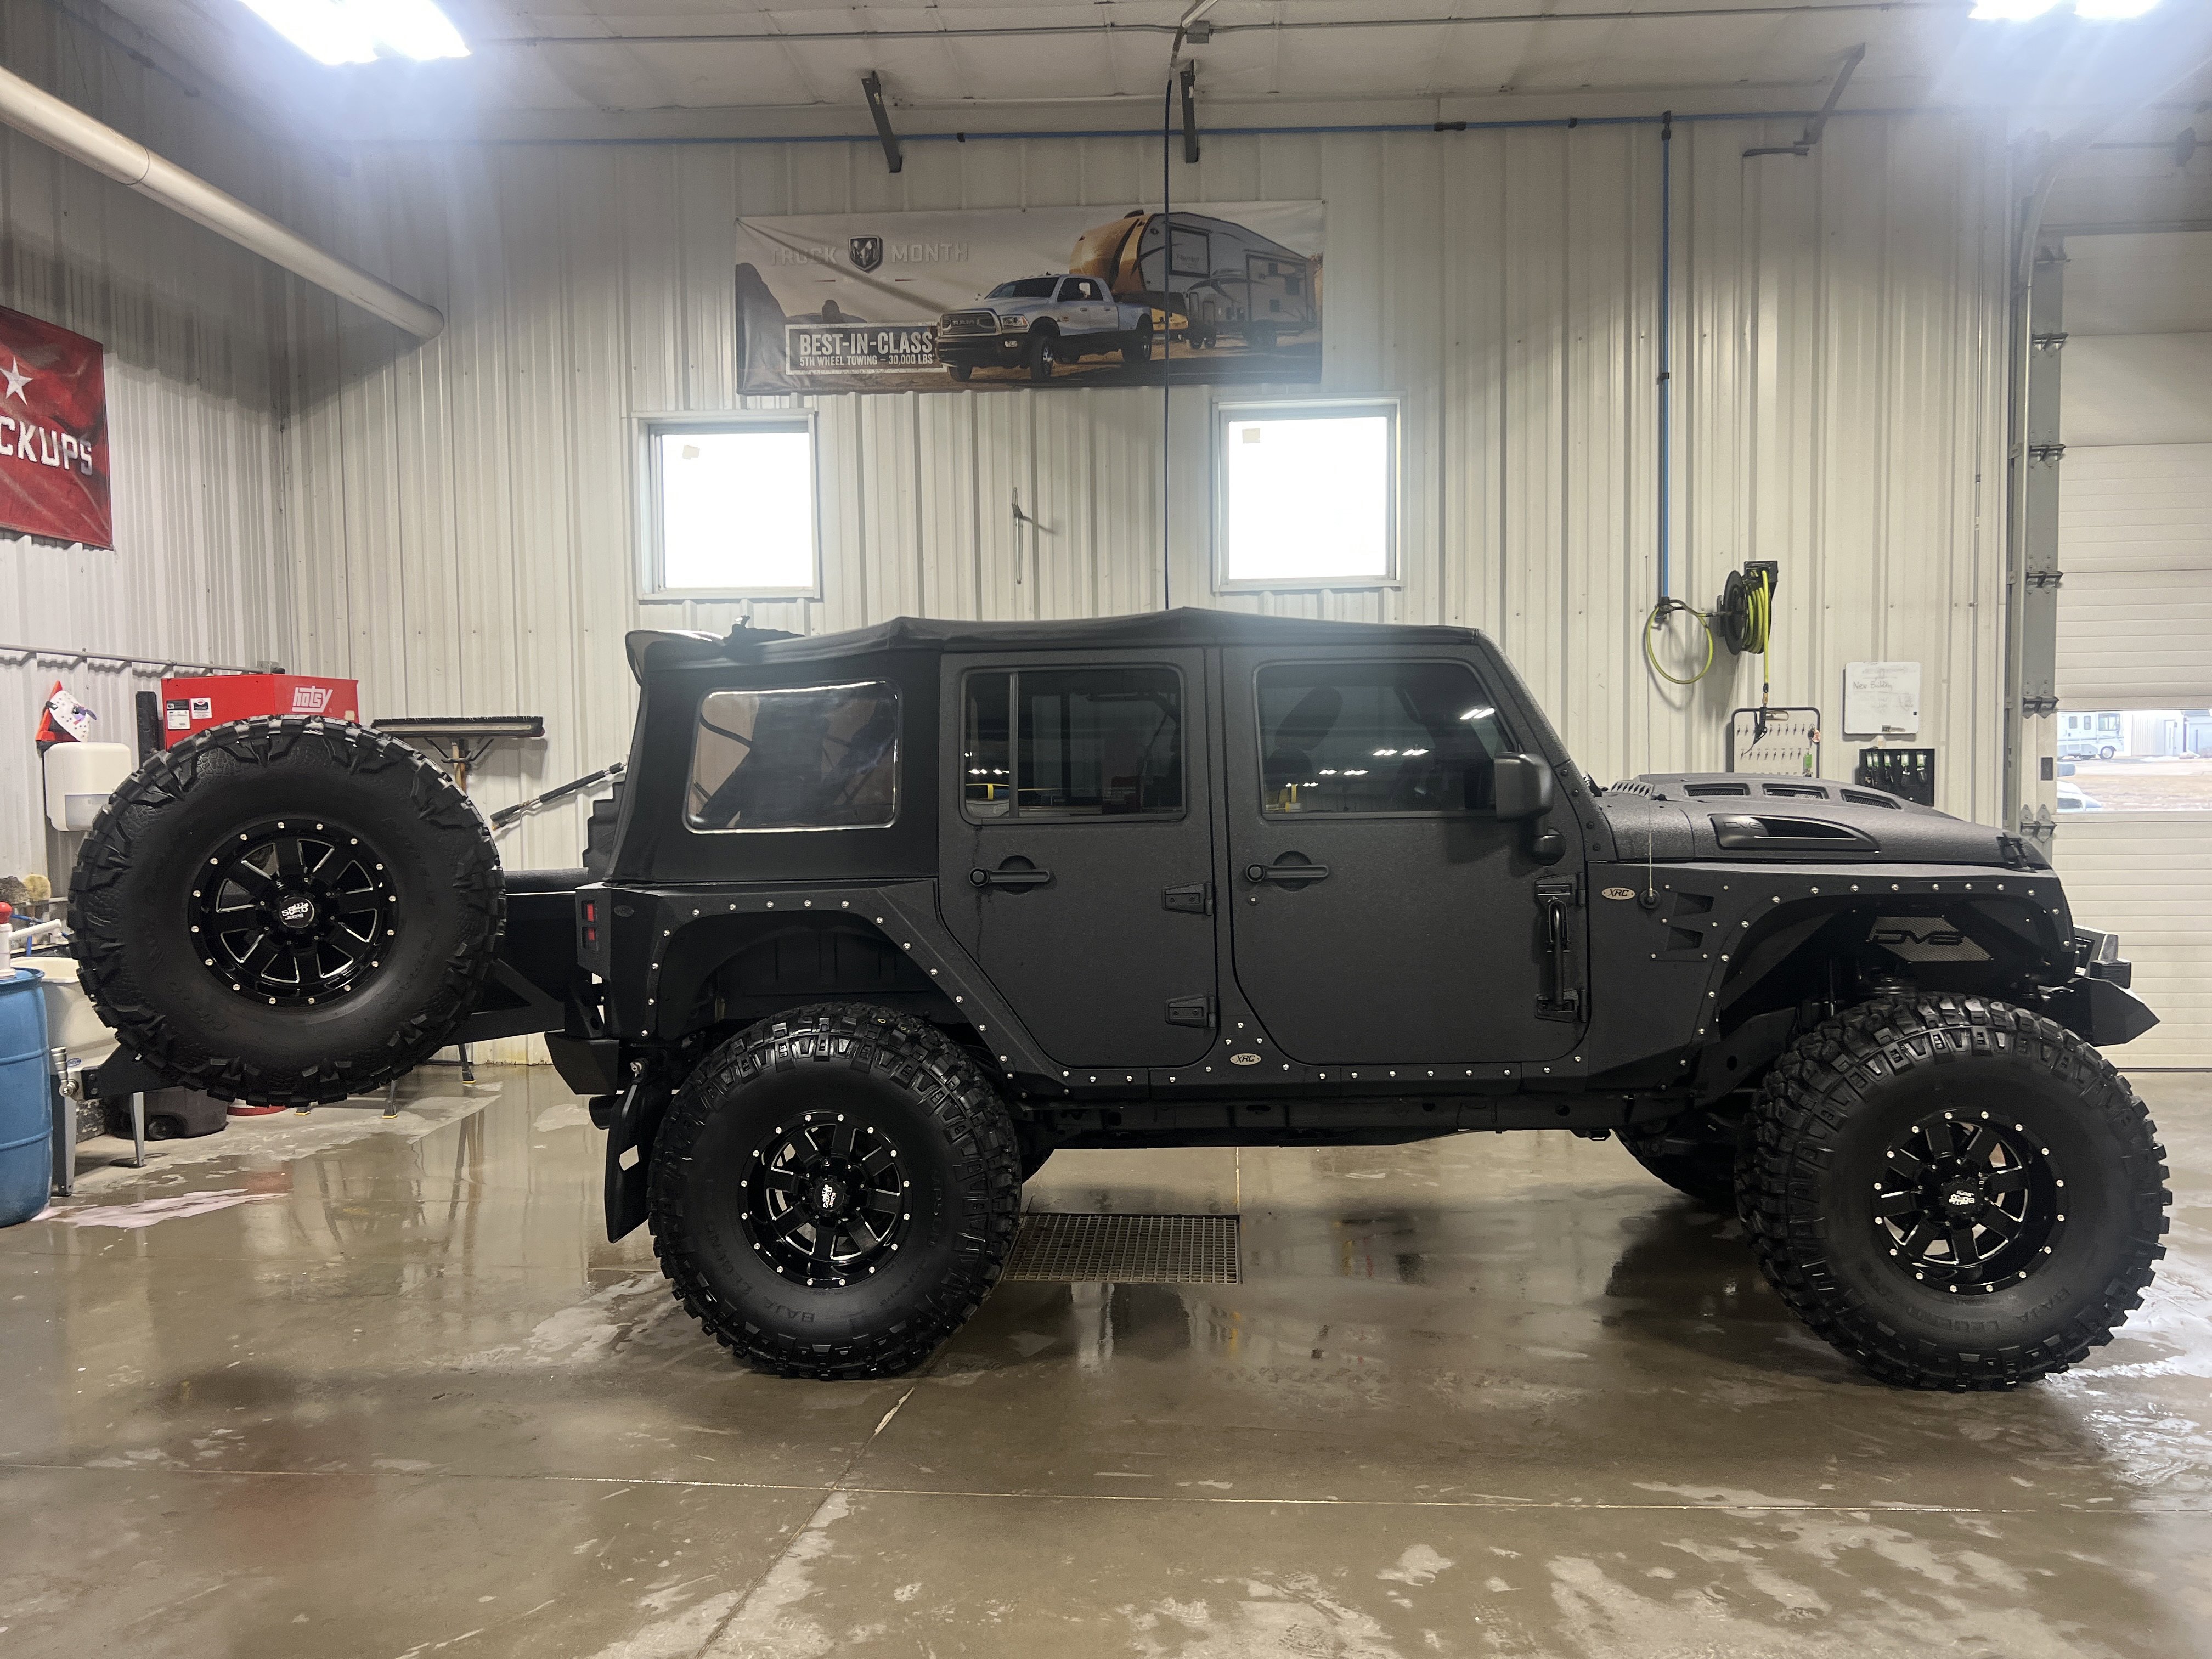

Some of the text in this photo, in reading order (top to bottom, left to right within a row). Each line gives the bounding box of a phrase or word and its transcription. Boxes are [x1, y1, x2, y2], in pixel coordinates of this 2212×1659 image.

[770, 242, 969, 266] TRUCK MONTH
[800, 331, 933, 356] BEST-IN-CLASS
[800, 357, 815, 366] 5TH
[816, 356, 845, 366] WHEEL
[847, 355, 878, 366] TOWING
[888, 354, 916, 365] 30,000
[0, 415, 93, 476] CKUPS
[1607, 888, 1629, 897] XRC
[1235, 1054, 1256, 1063] XRC
